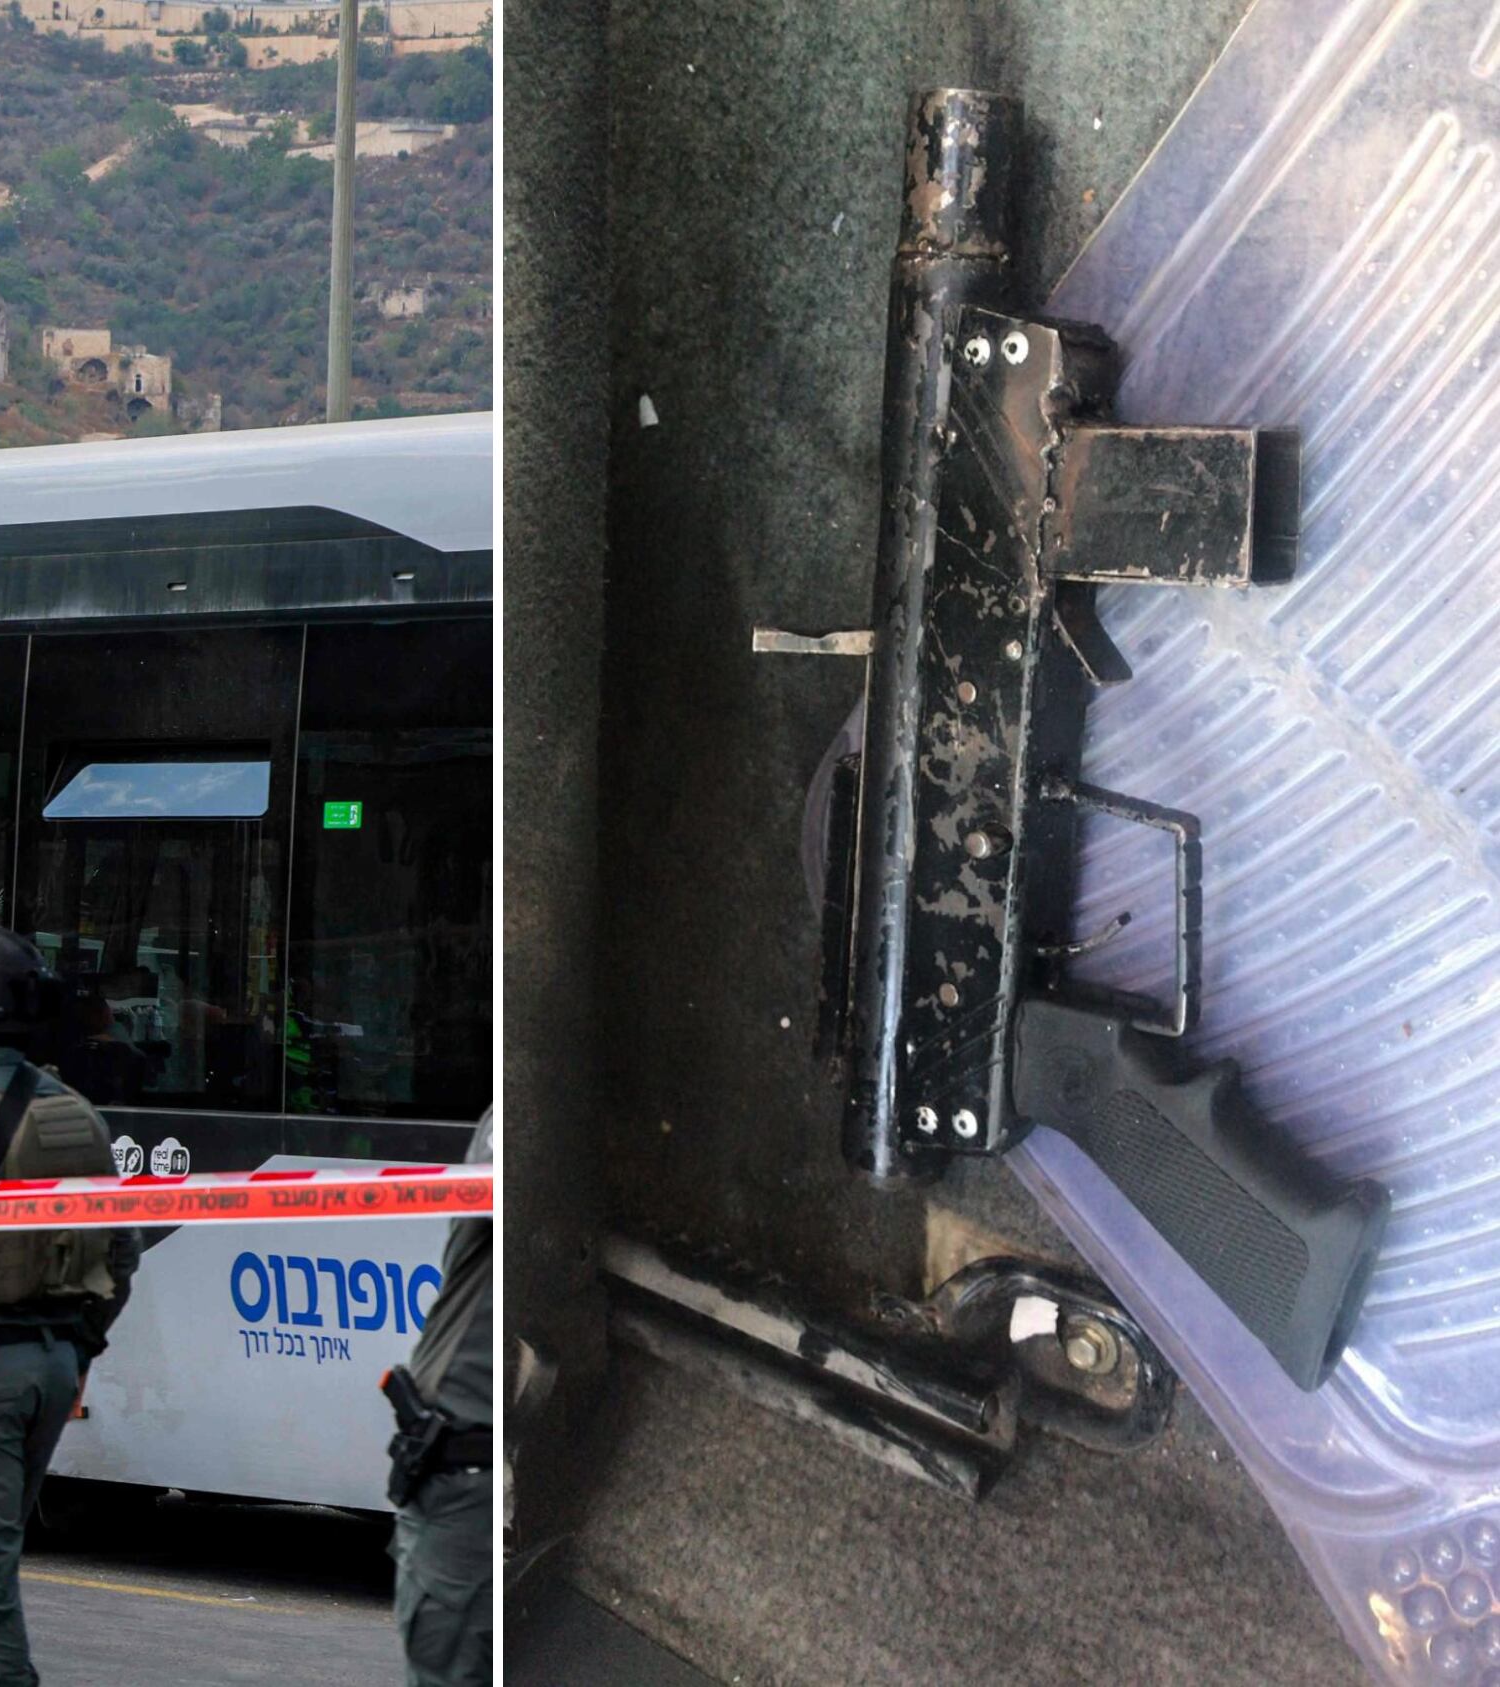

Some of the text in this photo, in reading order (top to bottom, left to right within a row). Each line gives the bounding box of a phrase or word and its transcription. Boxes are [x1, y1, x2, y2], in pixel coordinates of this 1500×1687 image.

[154, 1148, 169, 1160] real
[153, 1161, 170, 1172] time
[322, 1188, 348, 1210] אין
[230, 1251, 444, 1334] סופרבוס
[239, 1328, 351, 1364] איתך בכל דרך
